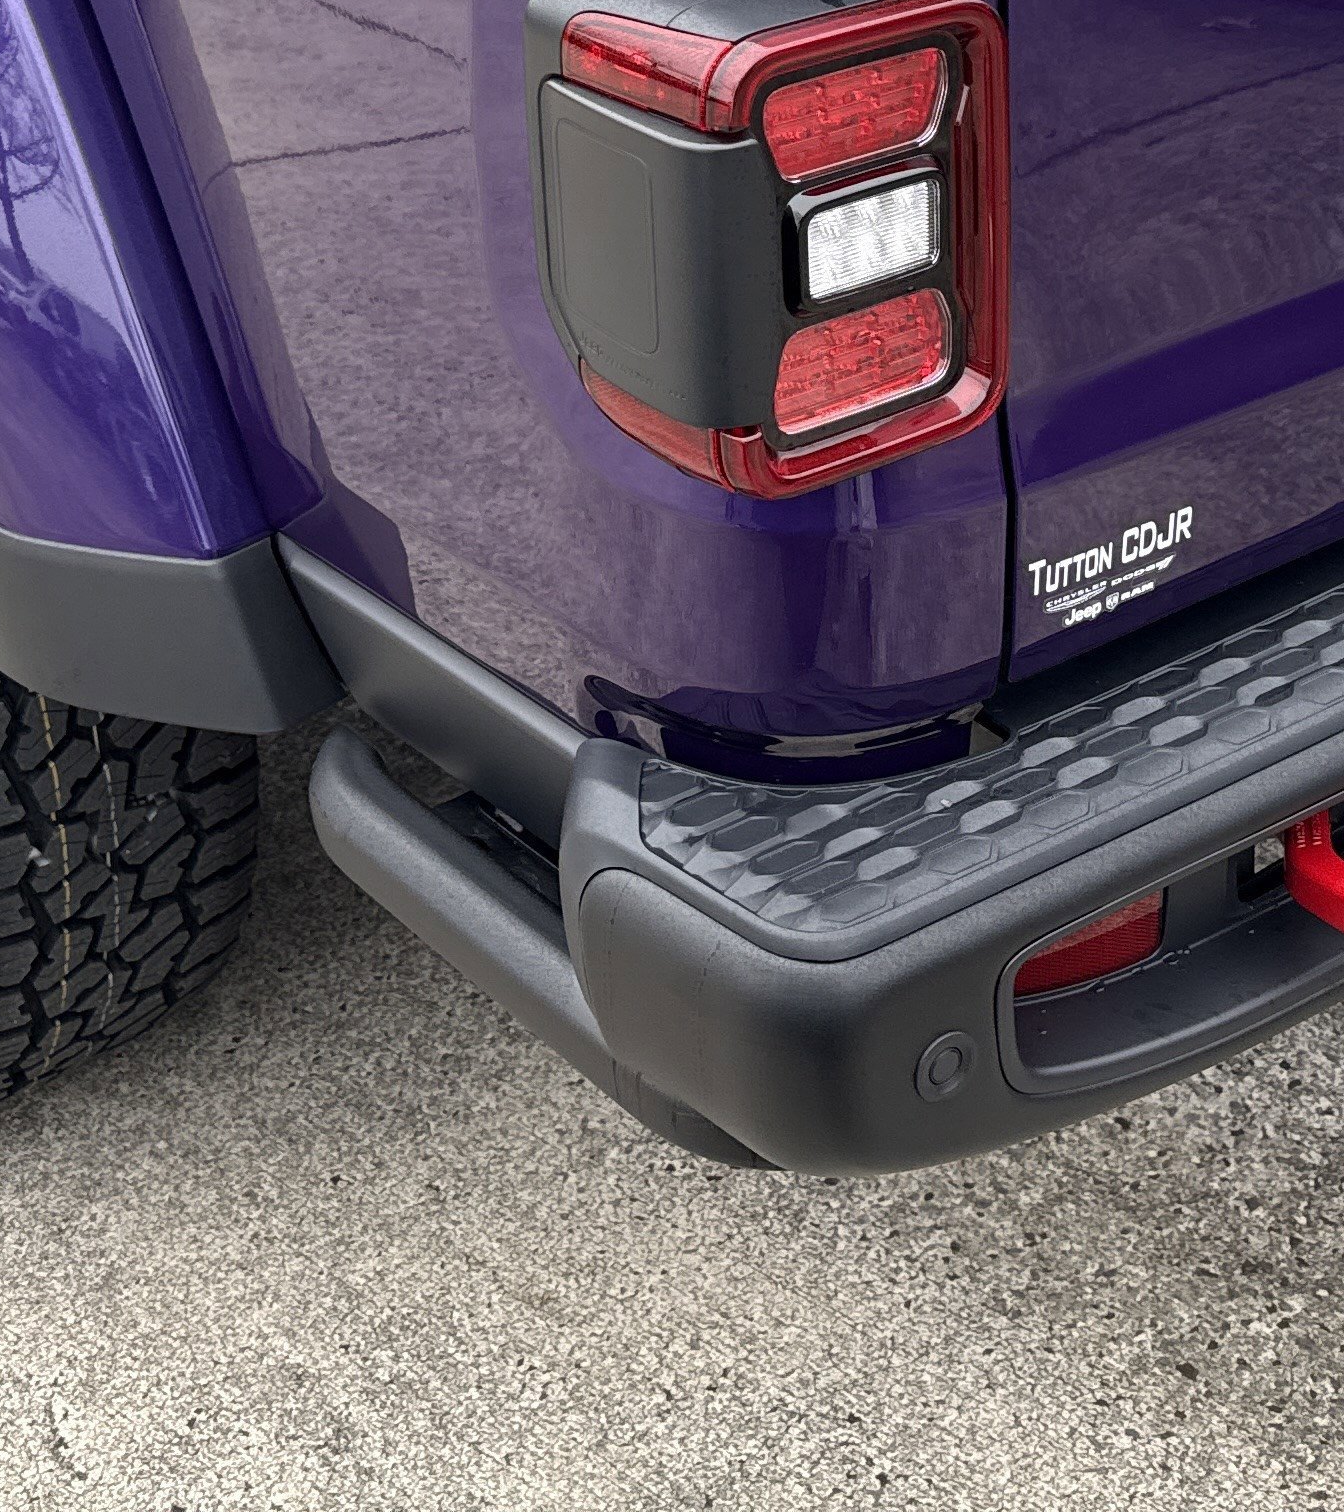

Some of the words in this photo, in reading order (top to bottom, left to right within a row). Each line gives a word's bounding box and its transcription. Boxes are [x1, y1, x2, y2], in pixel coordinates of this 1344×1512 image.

[1028, 541, 1113, 596] TUTTON
[1121, 506, 1193, 563] CDJR
[1045, 580, 1108, 608] CHRYSLER
[1064, 601, 1102, 626] Jeep
[1120, 581, 1155, 601] RAM
